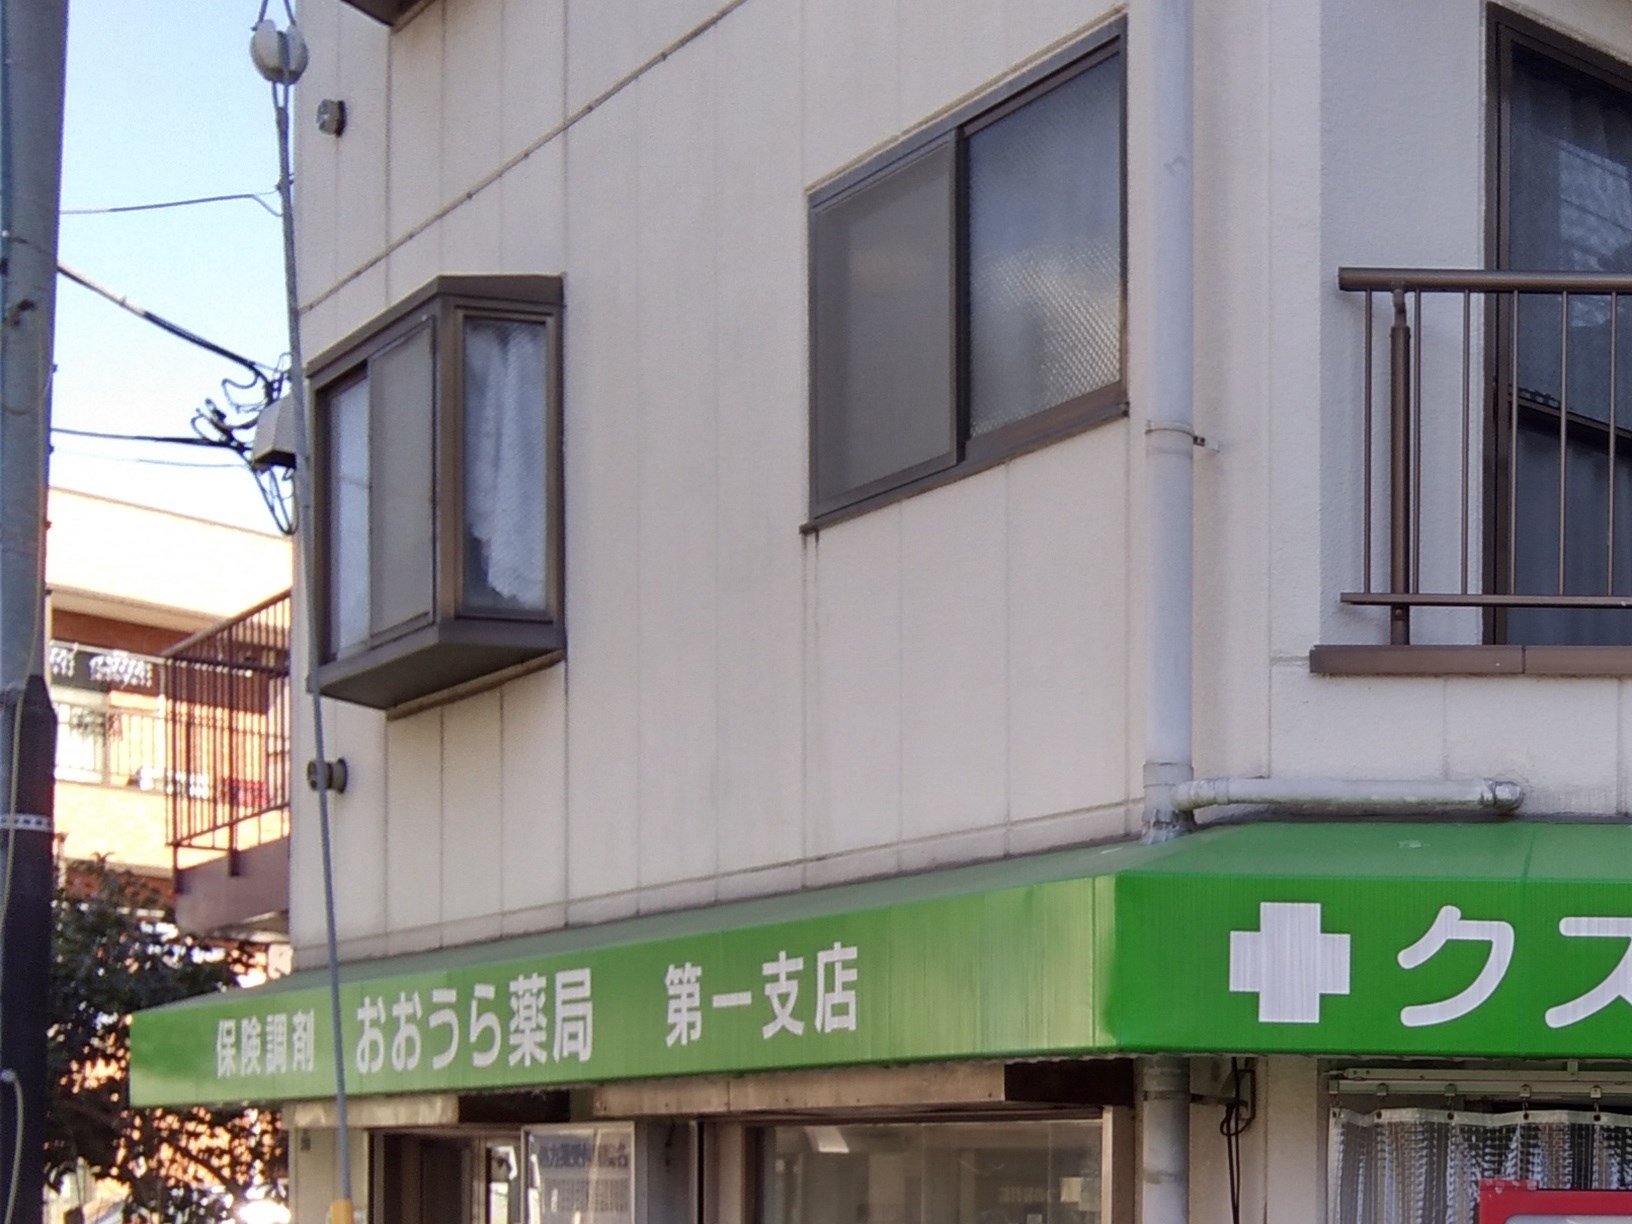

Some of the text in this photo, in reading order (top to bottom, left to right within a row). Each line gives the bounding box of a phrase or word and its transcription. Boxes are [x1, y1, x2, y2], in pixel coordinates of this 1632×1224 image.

[216, 942, 860, 1079] 保険調剤 おおうら薬局 第一支店
